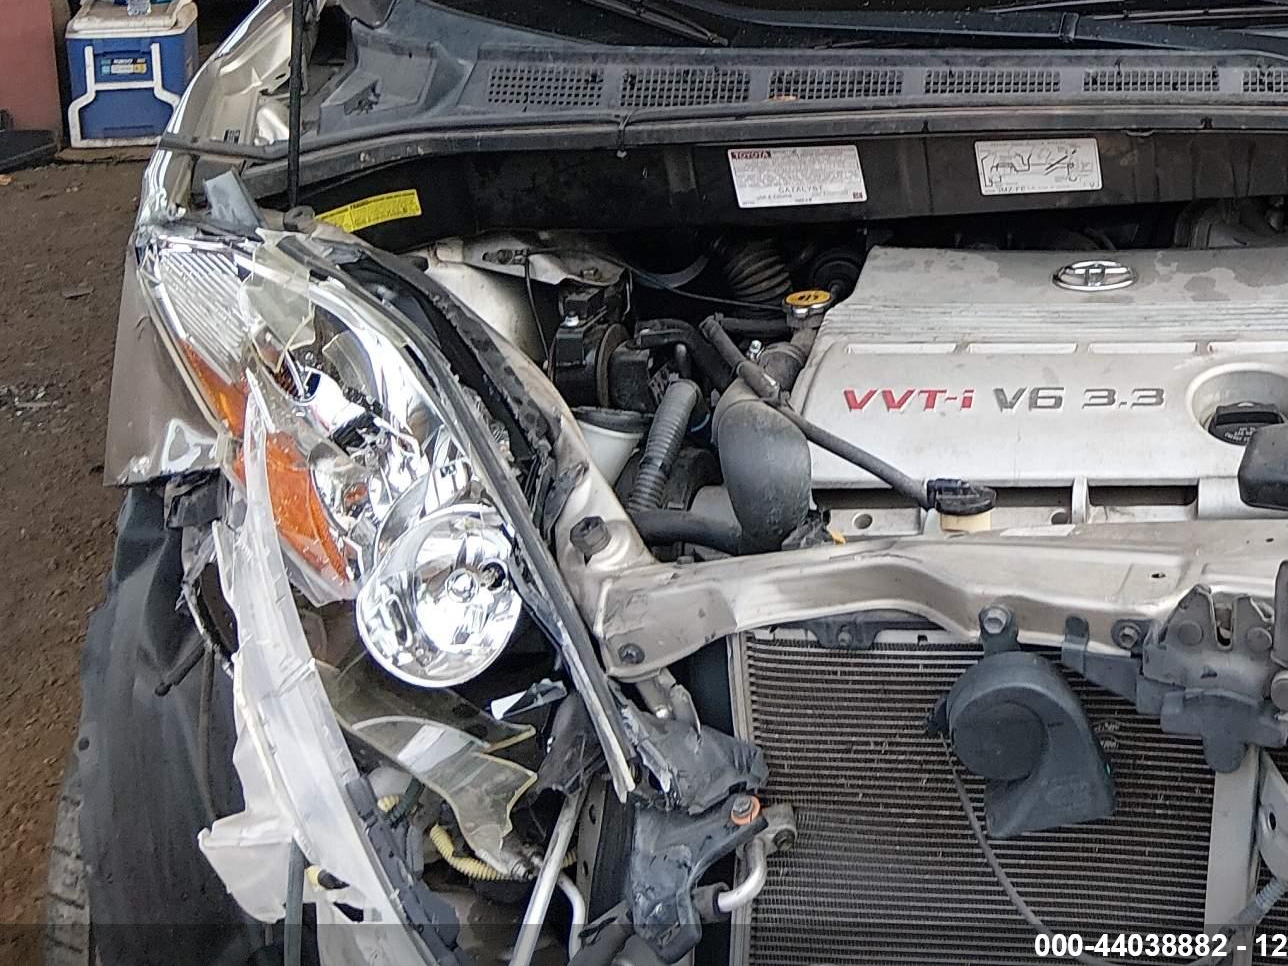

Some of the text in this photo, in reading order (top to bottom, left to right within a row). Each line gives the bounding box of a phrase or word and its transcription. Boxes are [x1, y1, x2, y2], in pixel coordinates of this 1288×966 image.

[731, 150, 770, 160] TOYOTA
[843, 386, 1165, 412] VVT-i V6 3.3
